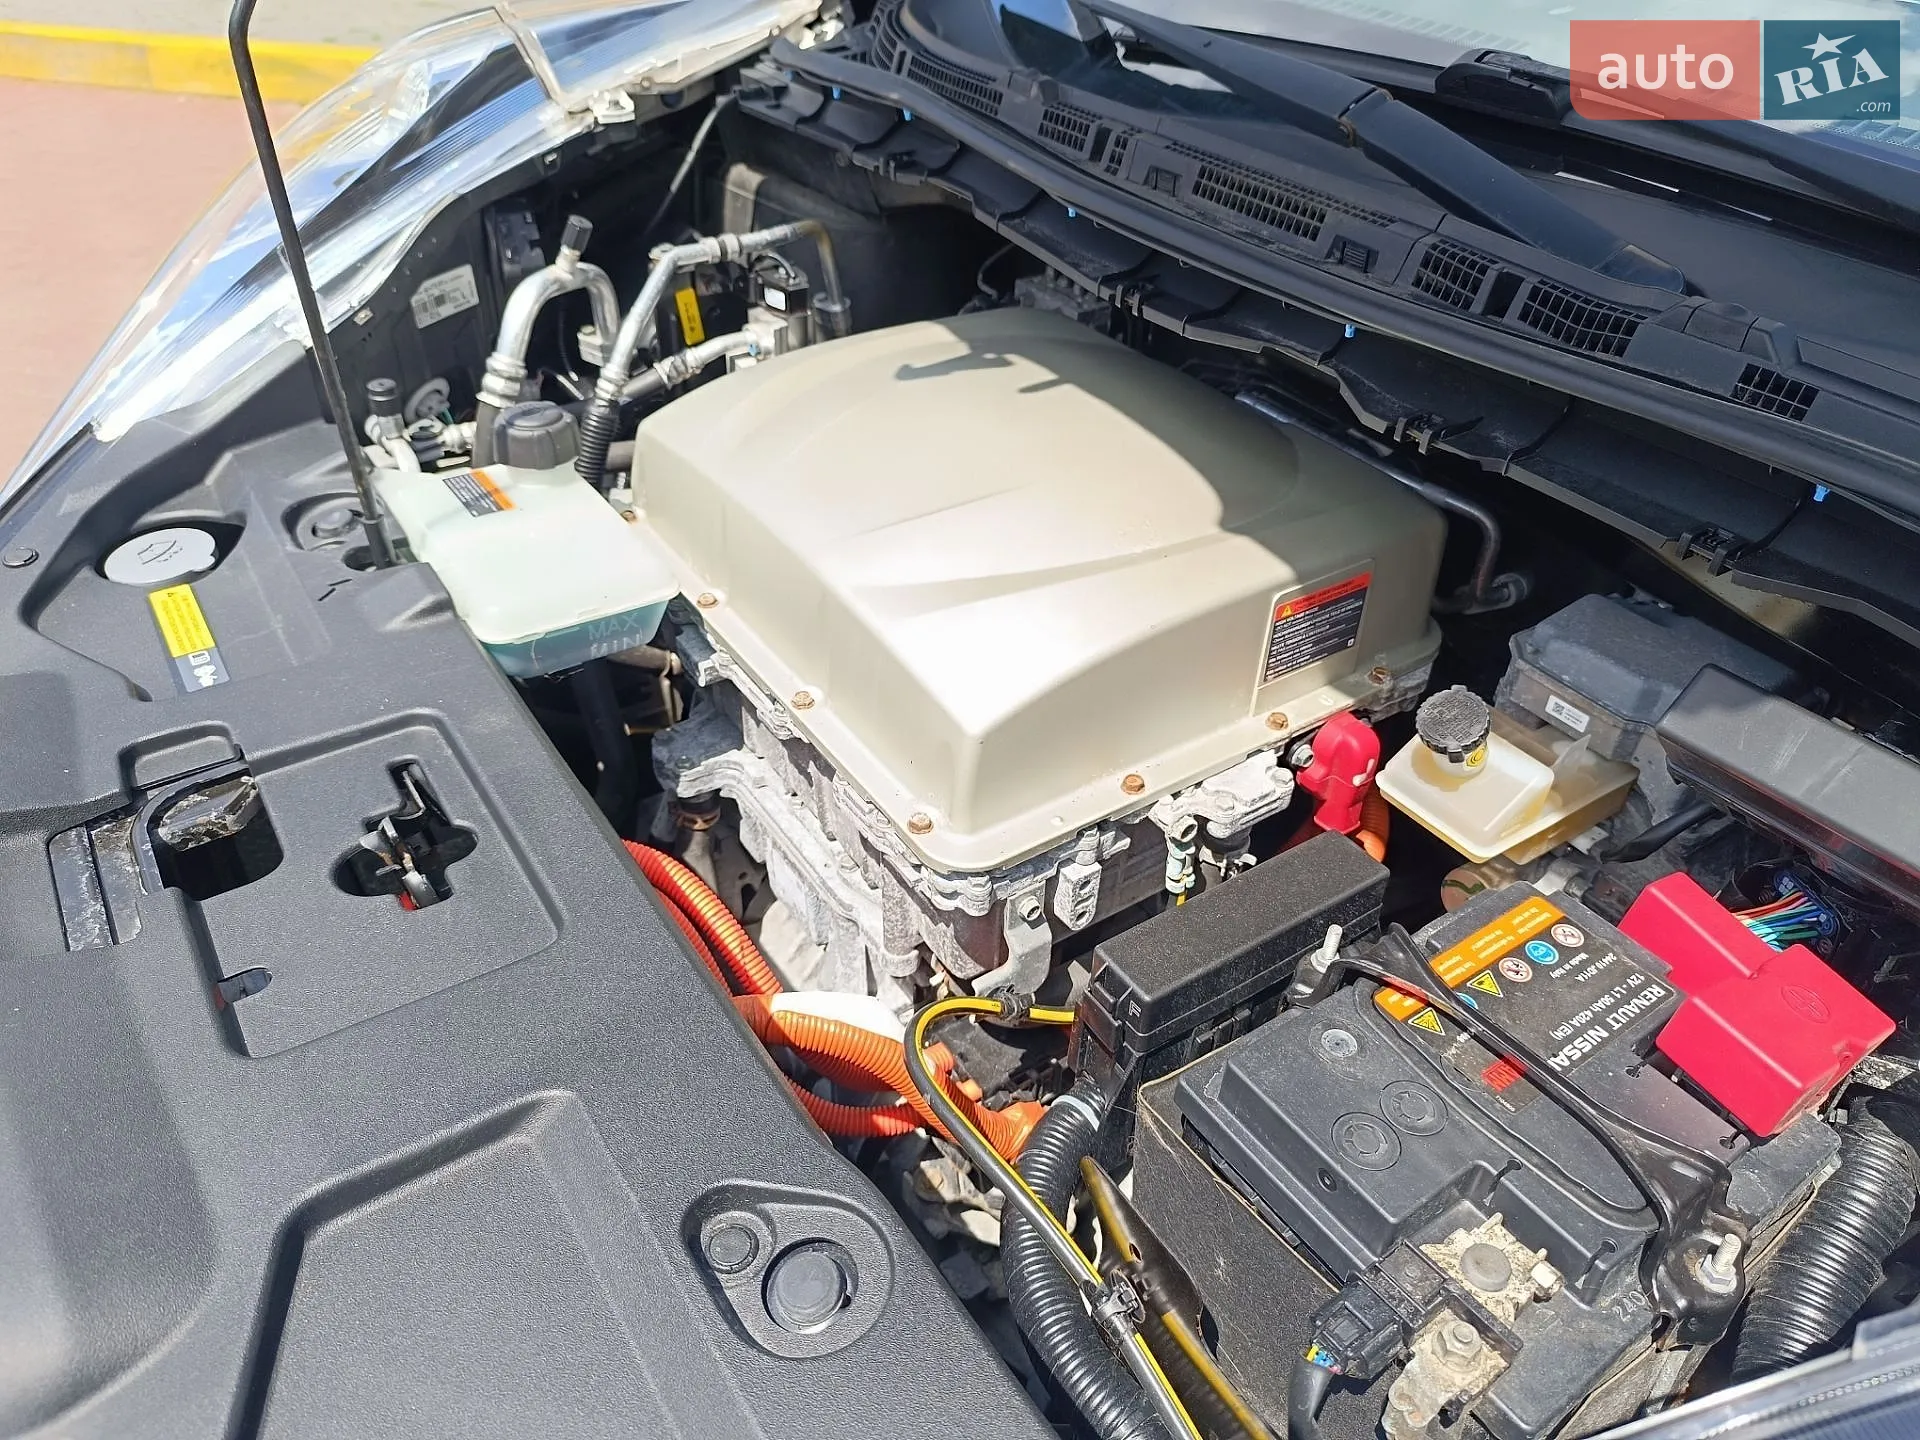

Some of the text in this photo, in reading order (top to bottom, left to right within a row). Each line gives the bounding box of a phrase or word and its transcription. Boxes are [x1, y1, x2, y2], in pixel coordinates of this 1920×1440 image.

[588, 612, 640, 641] MAX
[590, 633, 640, 660] MIN
[1569, 952, 1590, 967] Made
[1595, 952, 1618, 970] 24410
[1626, 972, 1645, 988] 12V
[1610, 986, 1627, 999] L1
[1589, 994, 1616, 1012] 50Ah
[1605, 984, 1666, 1031] RENAULT
[1568, 1009, 1594, 1027] 420A
[1548, 1021, 1575, 1041] (EN)
